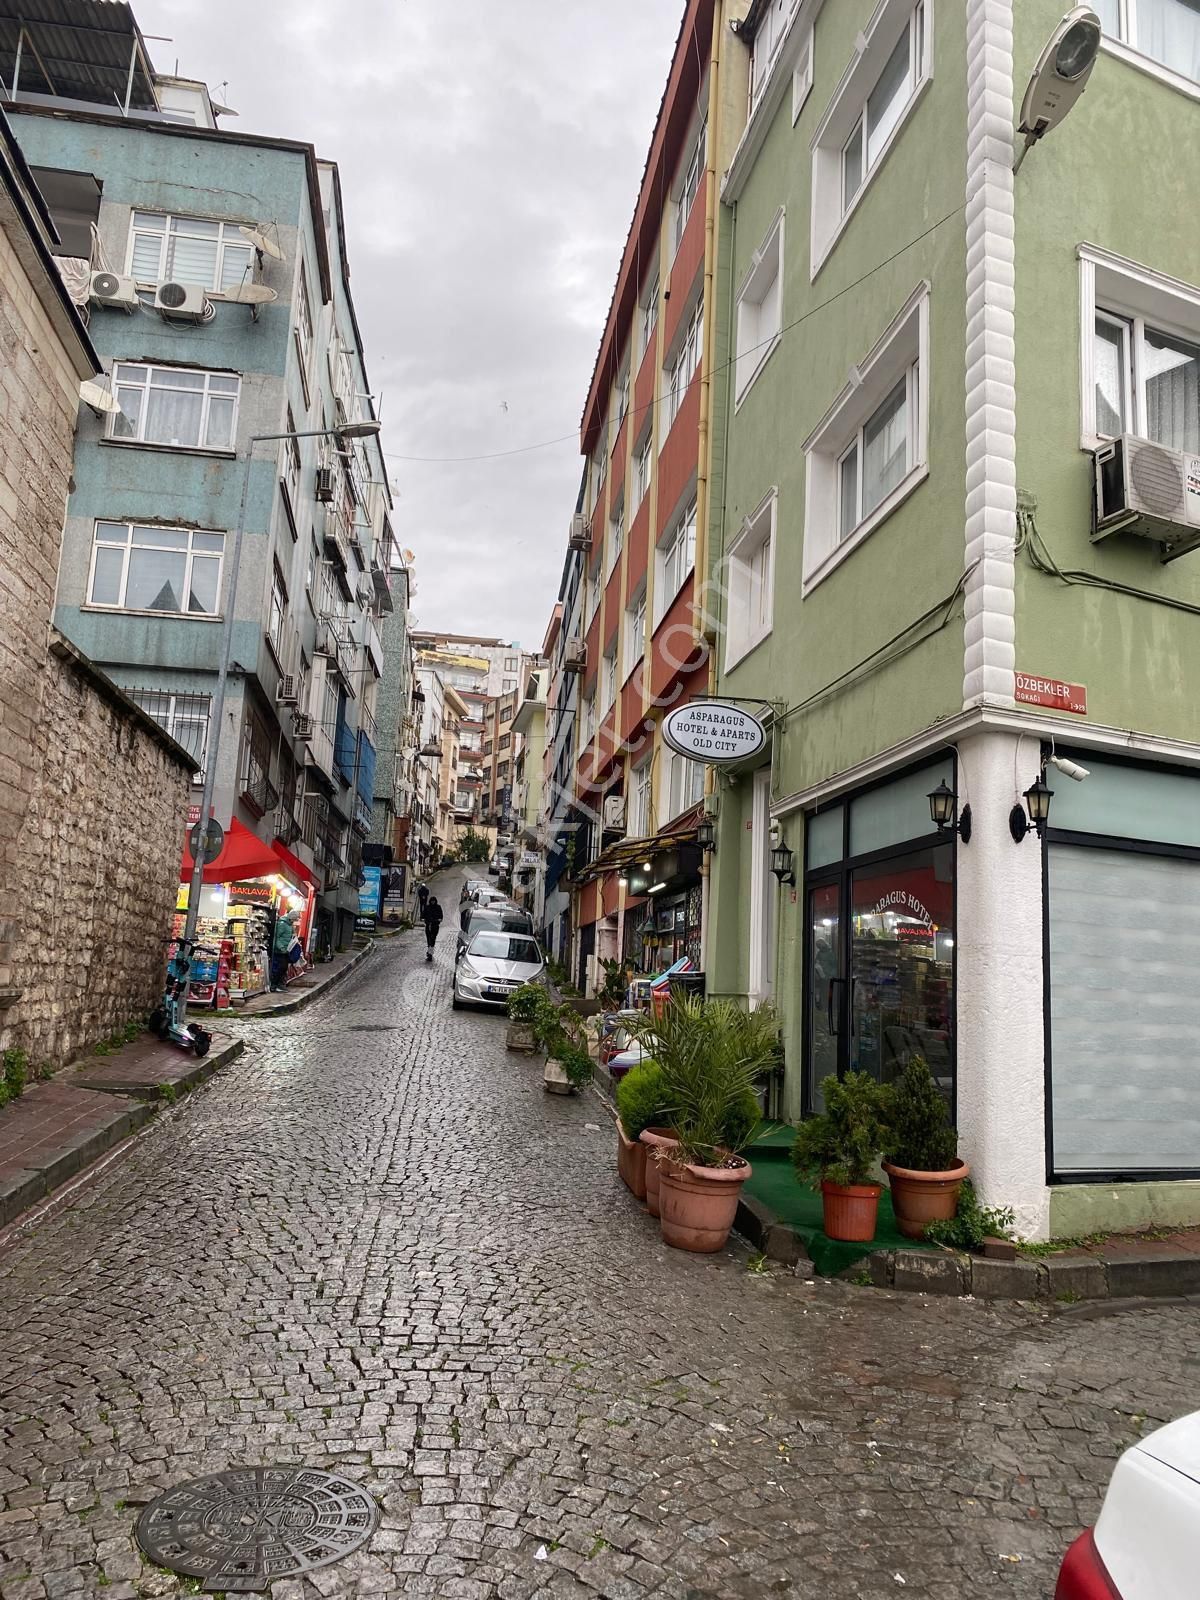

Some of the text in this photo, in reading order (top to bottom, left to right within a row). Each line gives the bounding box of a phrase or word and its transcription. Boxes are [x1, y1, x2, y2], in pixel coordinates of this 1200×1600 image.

[1016, 674, 1070, 698] ÖZBEKLER
[689, 711, 745, 726] ASPARAGUS
[677, 722, 756, 741] HOTEL & APARTS
[693, 738, 737, 752] OLD CITY
